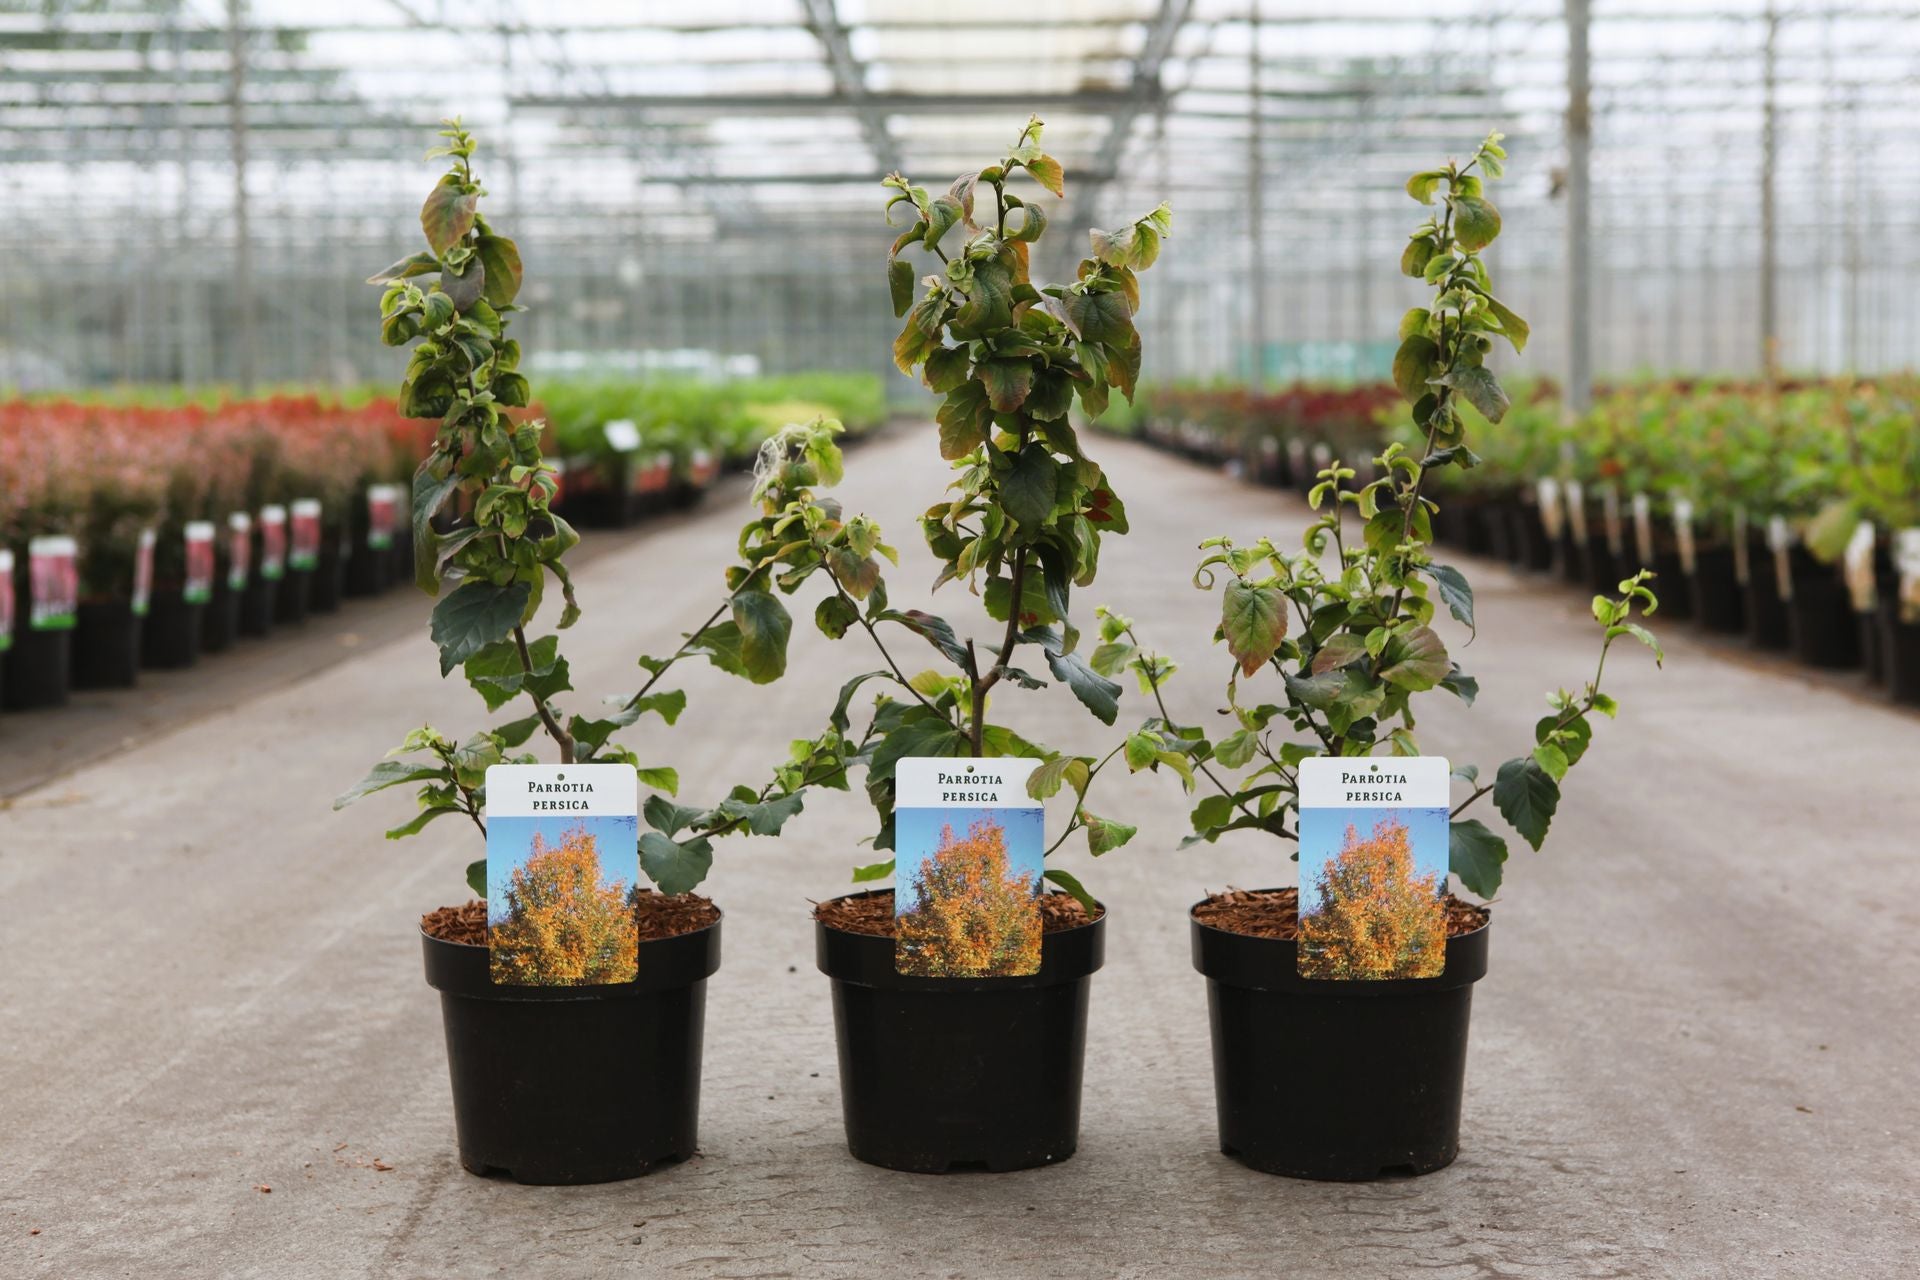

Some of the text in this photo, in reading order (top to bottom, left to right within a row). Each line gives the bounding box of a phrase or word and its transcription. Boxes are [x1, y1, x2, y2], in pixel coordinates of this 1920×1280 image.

[938, 773, 1003, 785] PARROTIA
[1341, 772, 1408, 784] PARROTIA
[528, 781, 594, 793] PARROTIA
[942, 791, 999, 802] PERSICA
[1346, 791, 1403, 802] PERSICA
[532, 800, 590, 811] PERSICA
